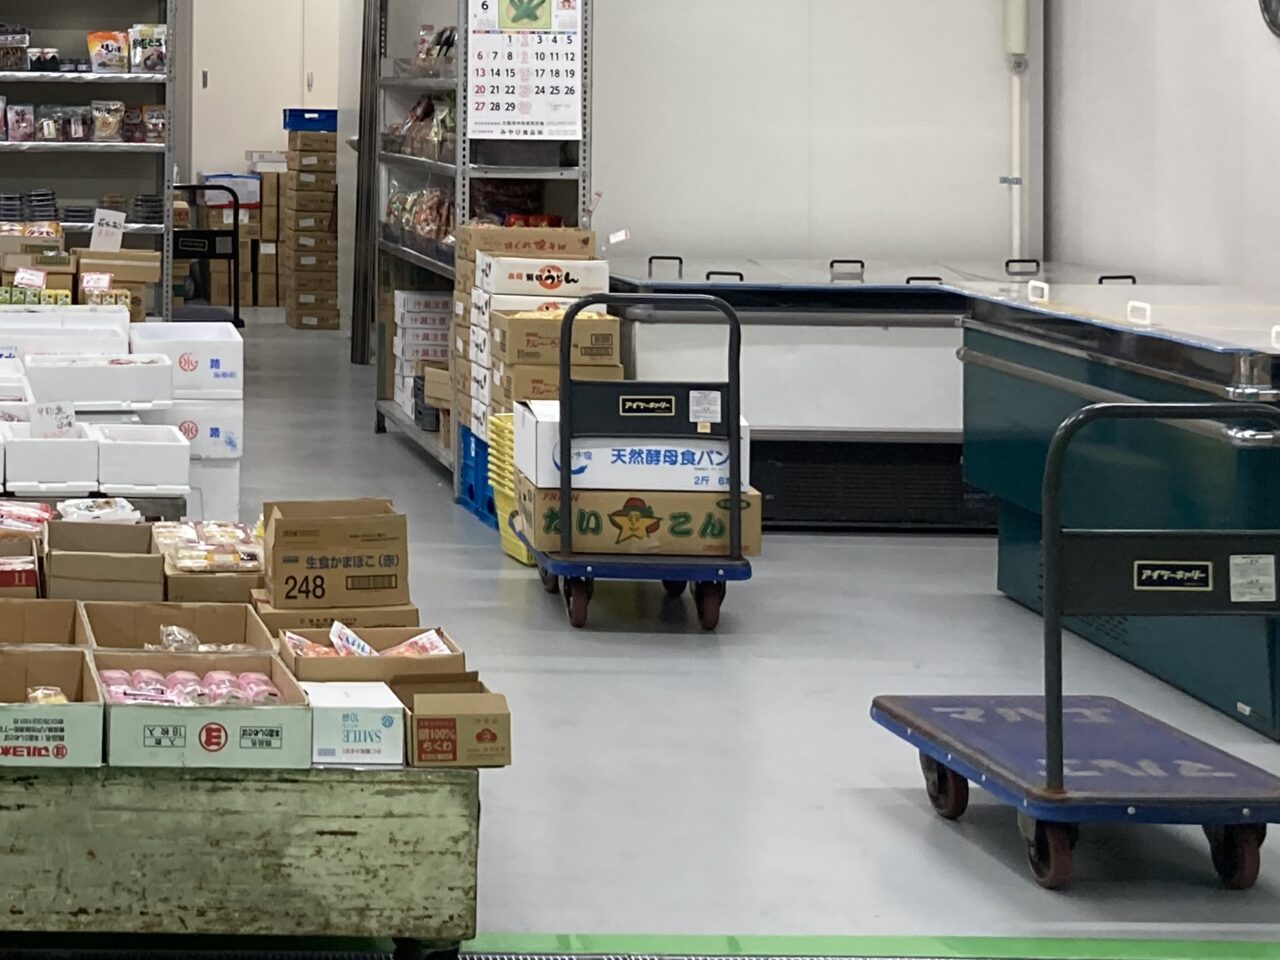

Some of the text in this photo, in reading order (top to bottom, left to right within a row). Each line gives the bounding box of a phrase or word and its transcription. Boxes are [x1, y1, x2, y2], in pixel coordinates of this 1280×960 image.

[481, 0, 489, 11] 6
[508, 35, 573, 44] 1 3 4 5
[477, 51, 575, 62] 6 7 8 10 11 12
[475, 68, 575, 79] 13 14 15 17 18 19
[475, 85, 575, 95] 20 21 22 24 25 26
[475, 102, 515, 111] 27 28 29
[611, 448, 730, 465] 天然酵母食パン
[284, 575, 326, 600] 248
[343, 730, 382, 743] SMILE
